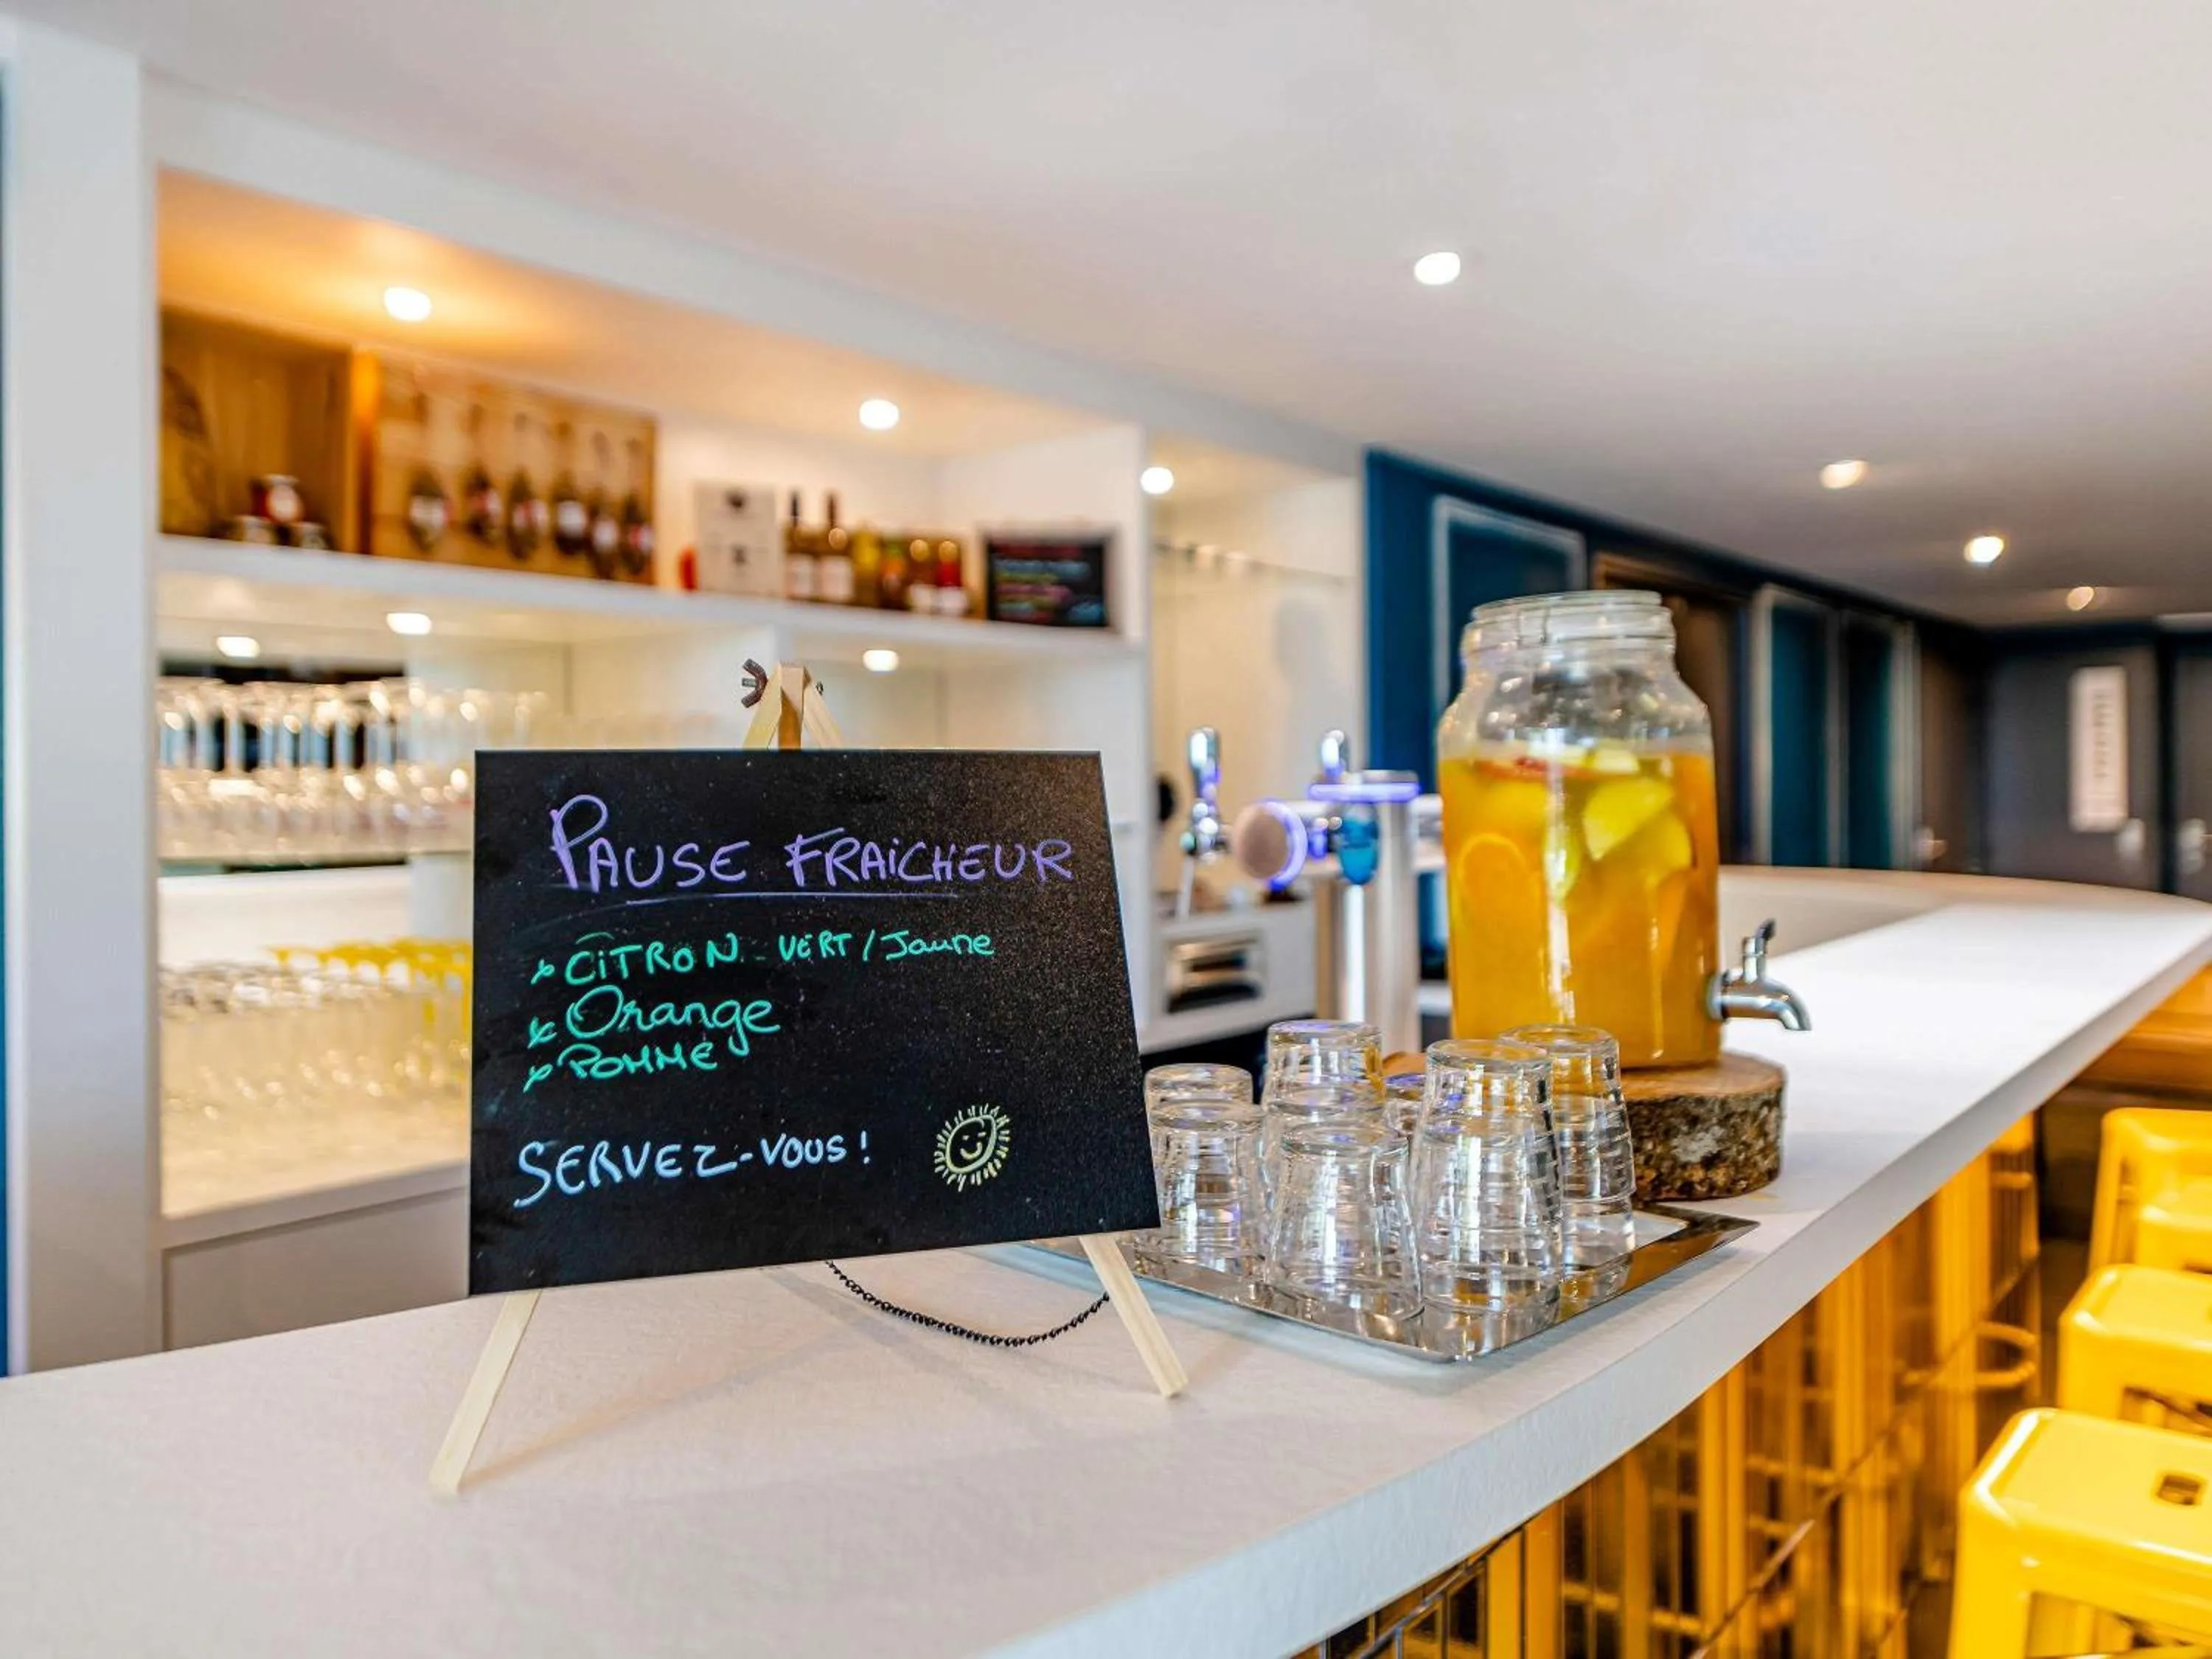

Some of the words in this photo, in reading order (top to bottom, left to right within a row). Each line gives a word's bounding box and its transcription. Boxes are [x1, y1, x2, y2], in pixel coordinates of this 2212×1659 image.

[550, 794, 751, 893] PAUSE
[566, 984, 781, 1057] Orange
[557, 1042, 717, 1080] POMME
